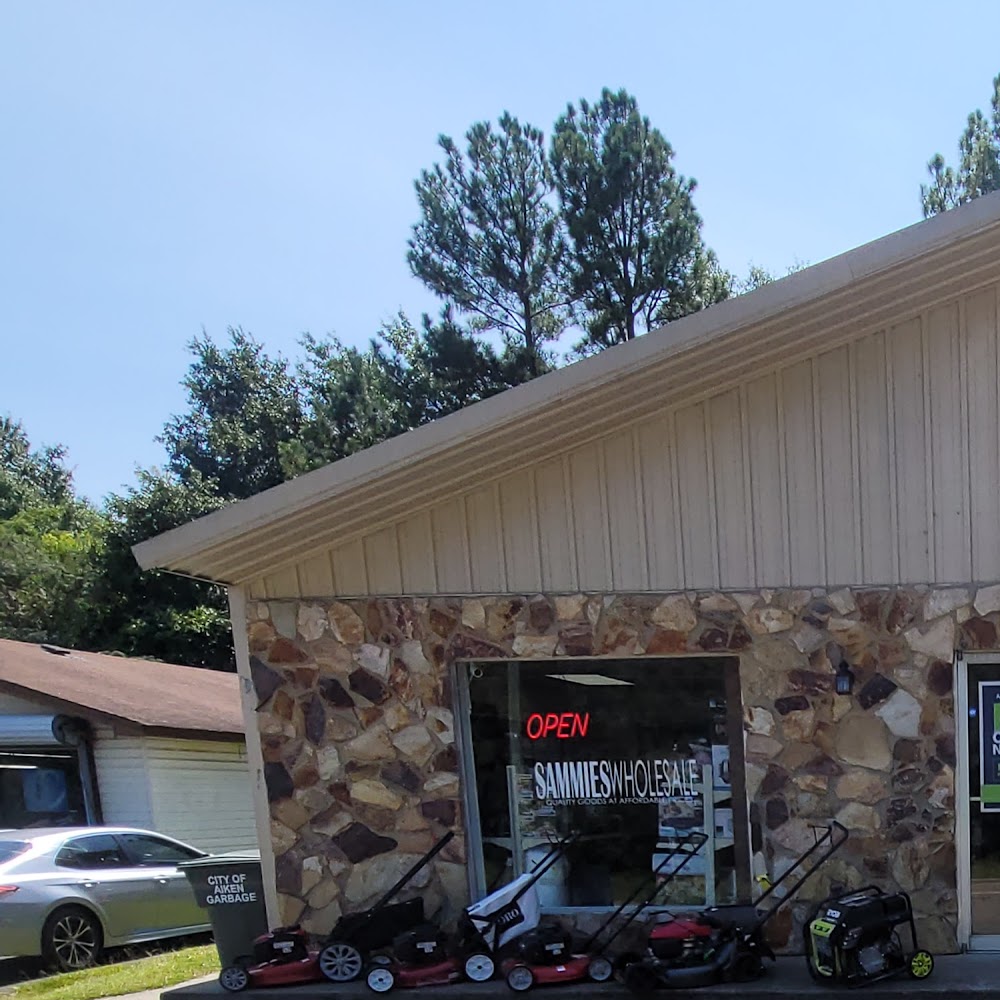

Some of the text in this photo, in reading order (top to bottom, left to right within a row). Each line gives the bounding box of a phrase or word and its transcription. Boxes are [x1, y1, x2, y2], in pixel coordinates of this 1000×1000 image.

[526, 712, 590, 740] OPEN
[207, 873, 246, 885] CITY OF
[214, 884, 245, 895] AIKEN
[206, 892, 257, 905] GARBAGE
